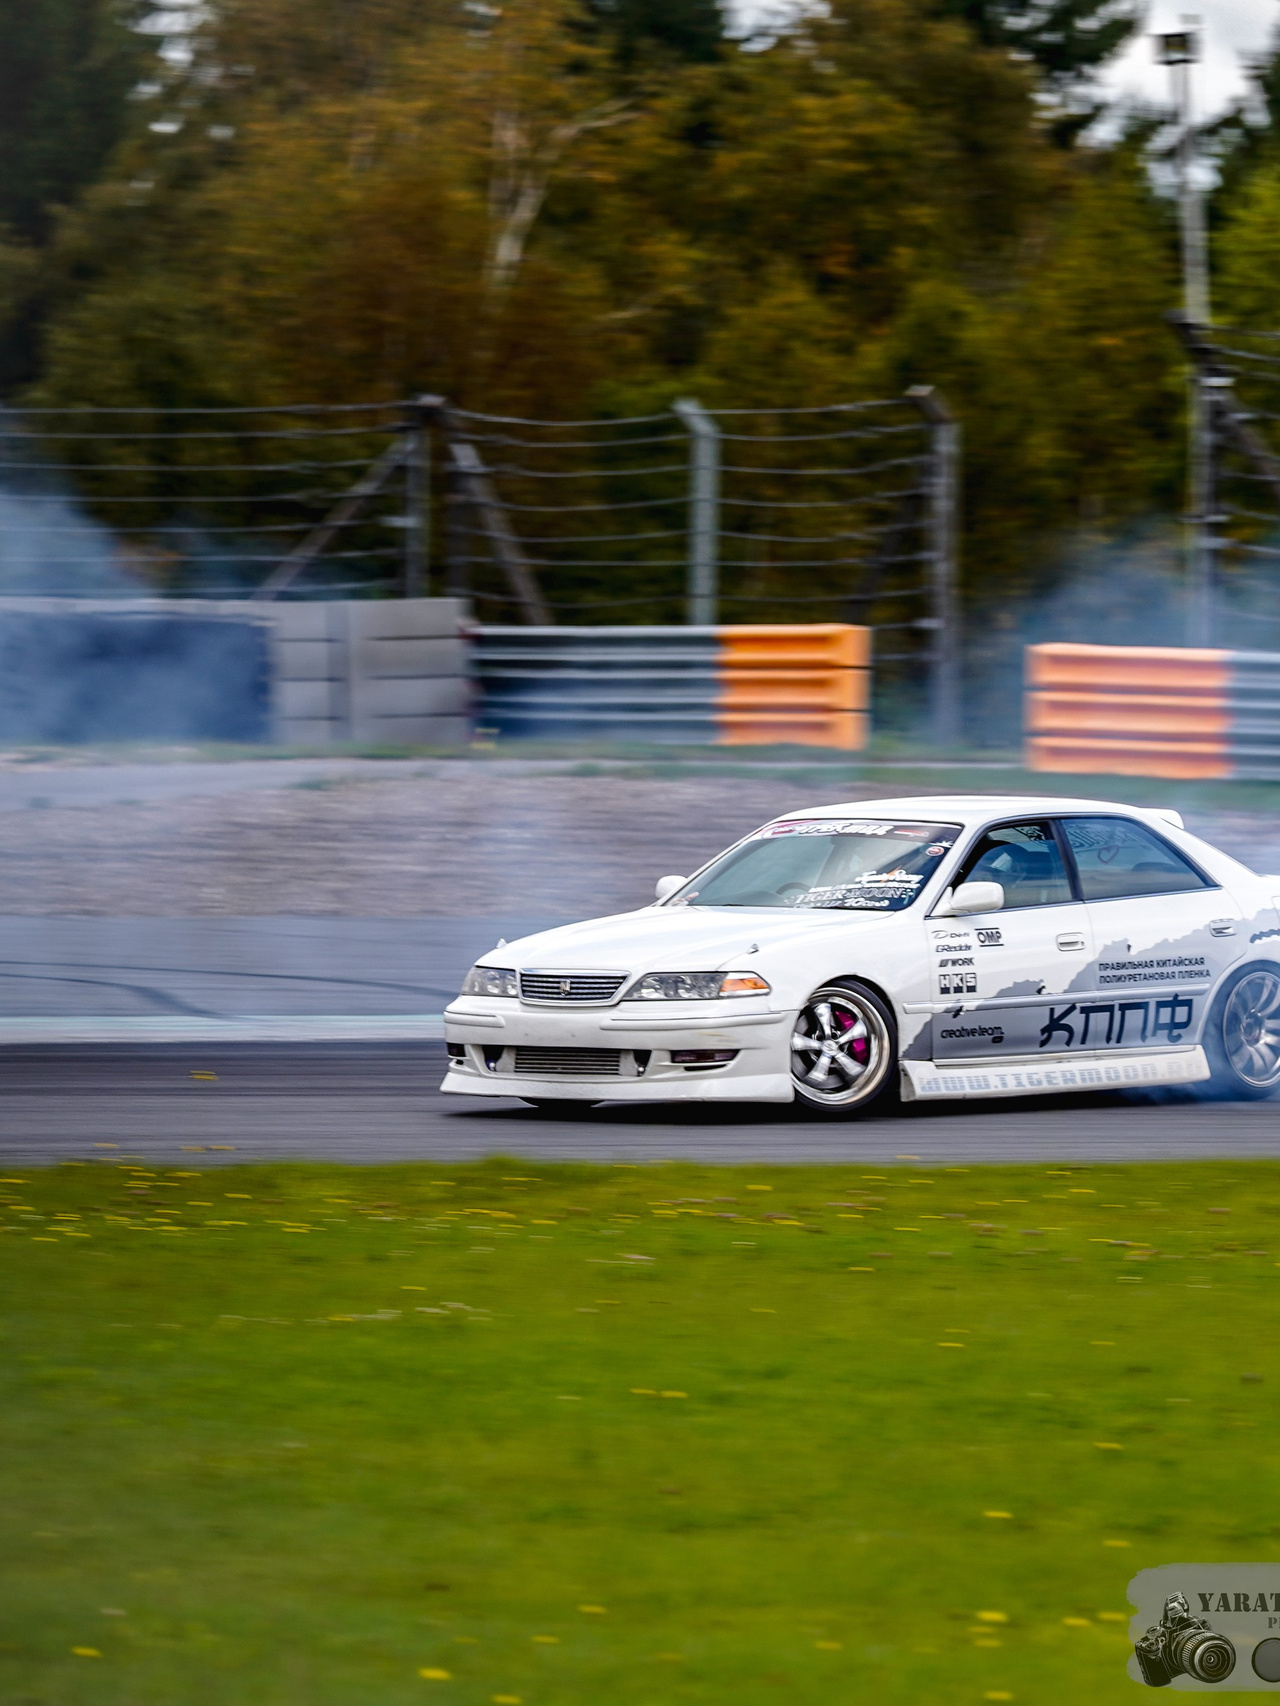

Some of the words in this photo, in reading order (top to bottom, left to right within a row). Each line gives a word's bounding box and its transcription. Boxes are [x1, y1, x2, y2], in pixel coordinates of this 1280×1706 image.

[795, 890, 847, 903] TIGER
[848, 888, 905, 899] MOON
[976, 930, 1003, 944] OMP
[950, 957, 975, 967] WORK
[1098, 959, 1155, 972] ПРАВИЛЬНАЯ
[1156, 956, 1206, 969] КИТАЙСКАЯ
[939, 973, 977, 992] HKS
[1099, 971, 1177, 985] ПОЛИУРЕТАНОВАЯ
[1177, 969, 1212, 981] ПЛЕНКА
[1039, 993, 1194, 1048] КППФ
